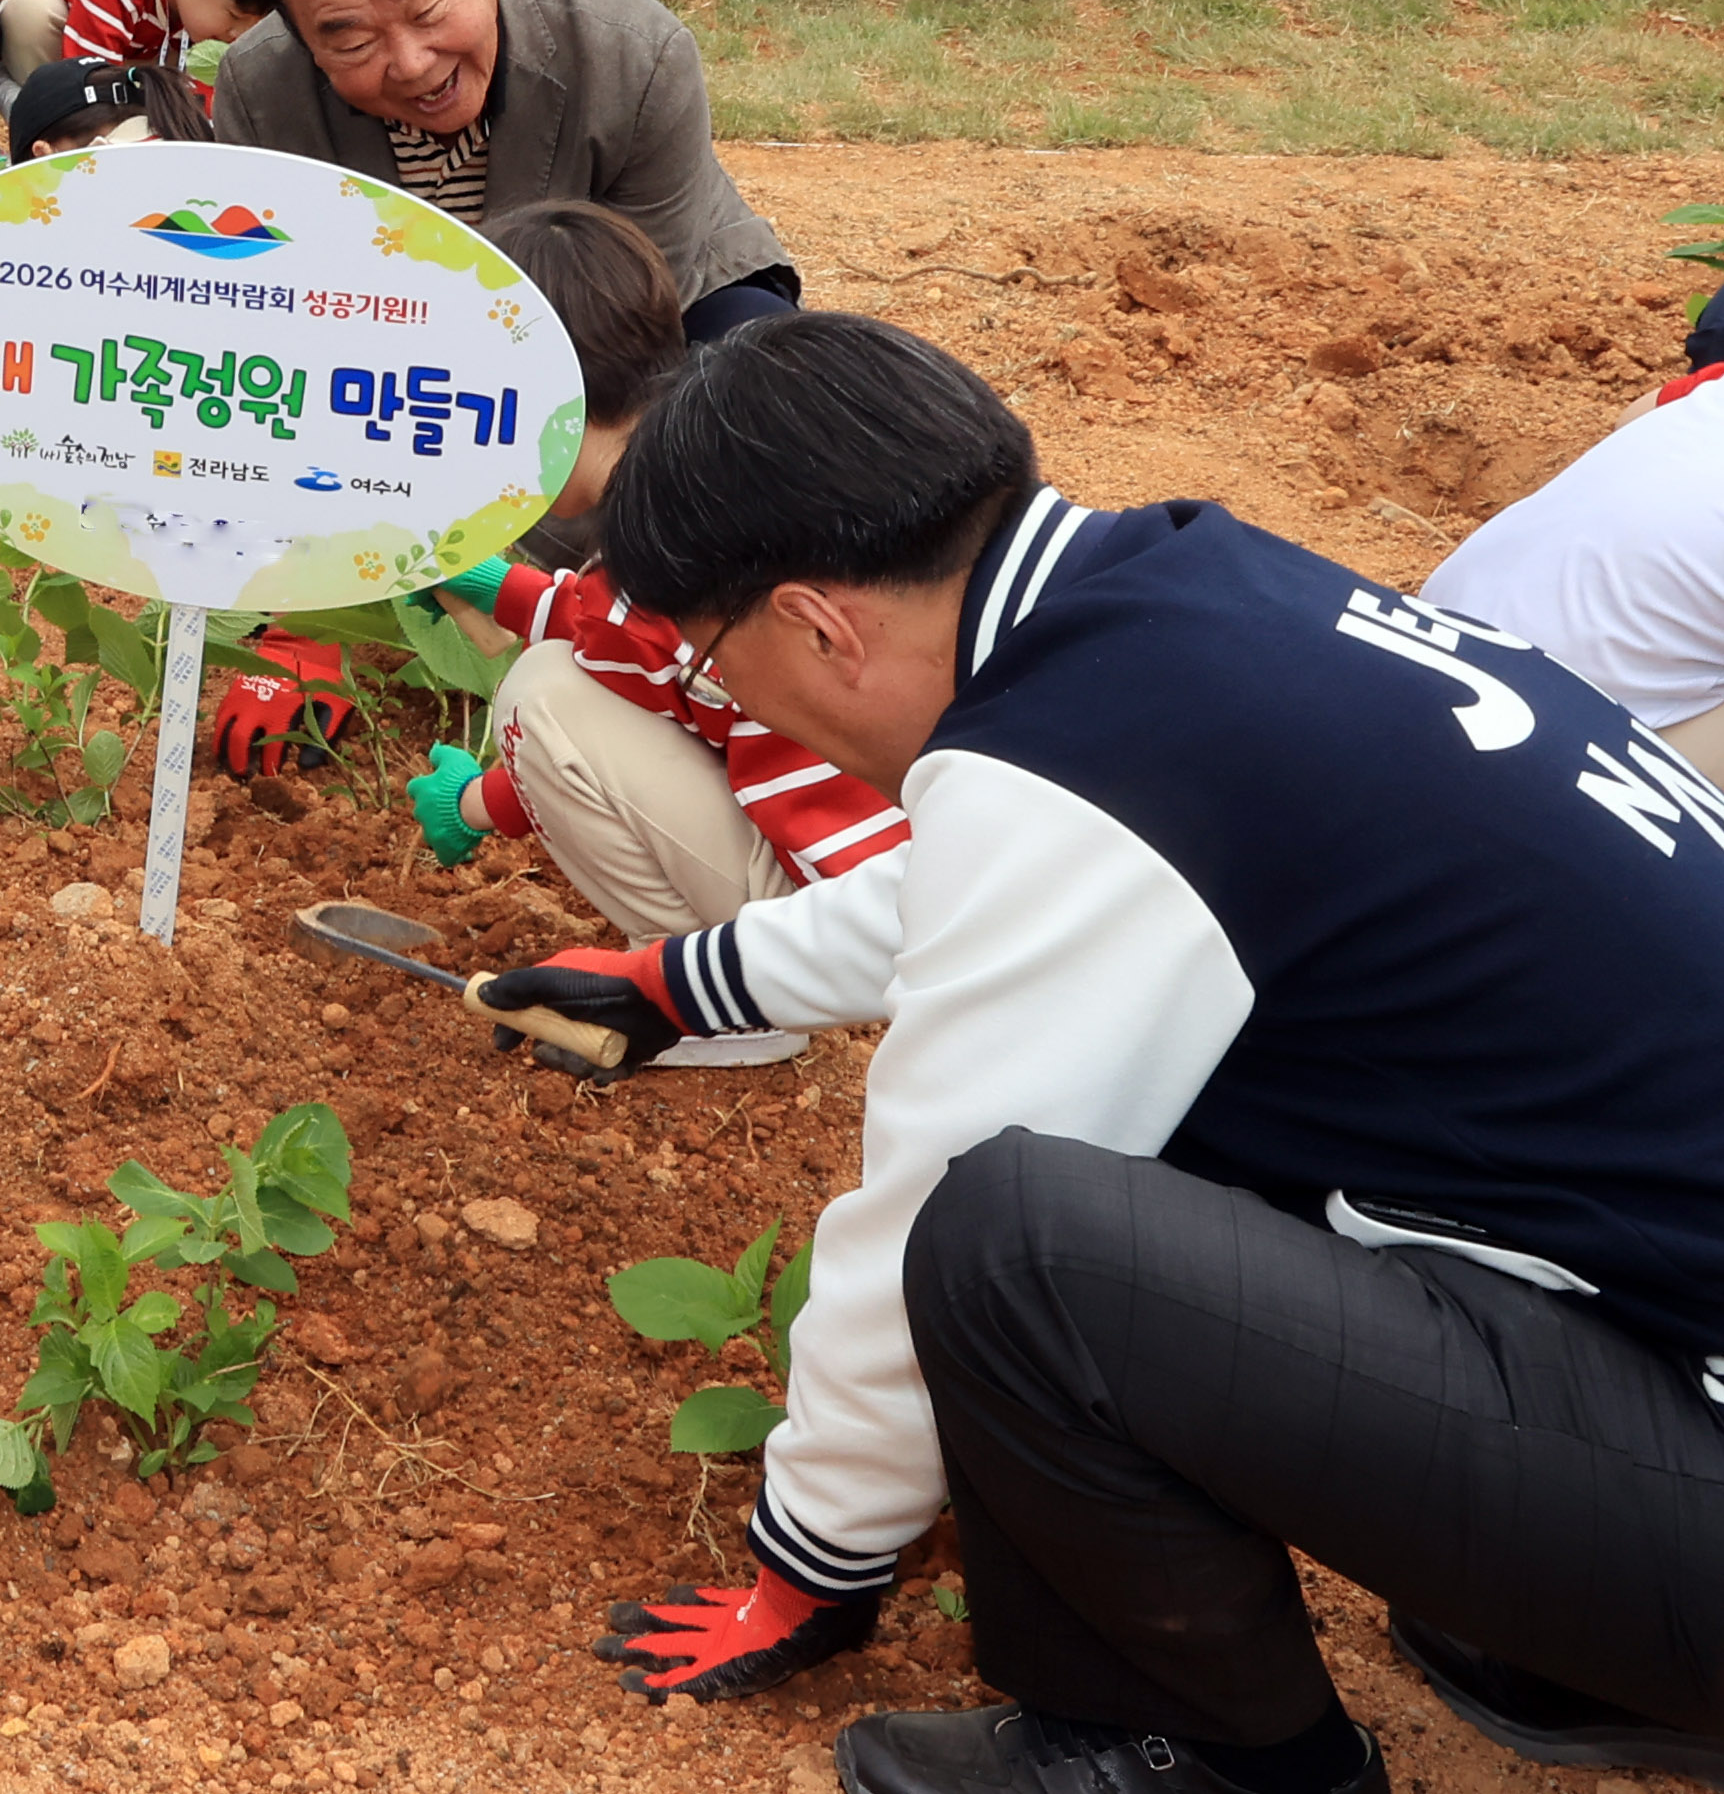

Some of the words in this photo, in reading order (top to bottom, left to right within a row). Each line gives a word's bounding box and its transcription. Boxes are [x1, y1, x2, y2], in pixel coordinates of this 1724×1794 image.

[80, 267, 295, 314] 여수세계섬박람회
[302, 289, 429, 326] 성공기원!!
[51, 334, 308, 441] 가족정원
[329, 365, 519, 458] 만들기
[188, 458, 271, 482] 전라남도
[350, 477, 412, 498] 여수시
[1336, 589, 1619, 751] JEO
